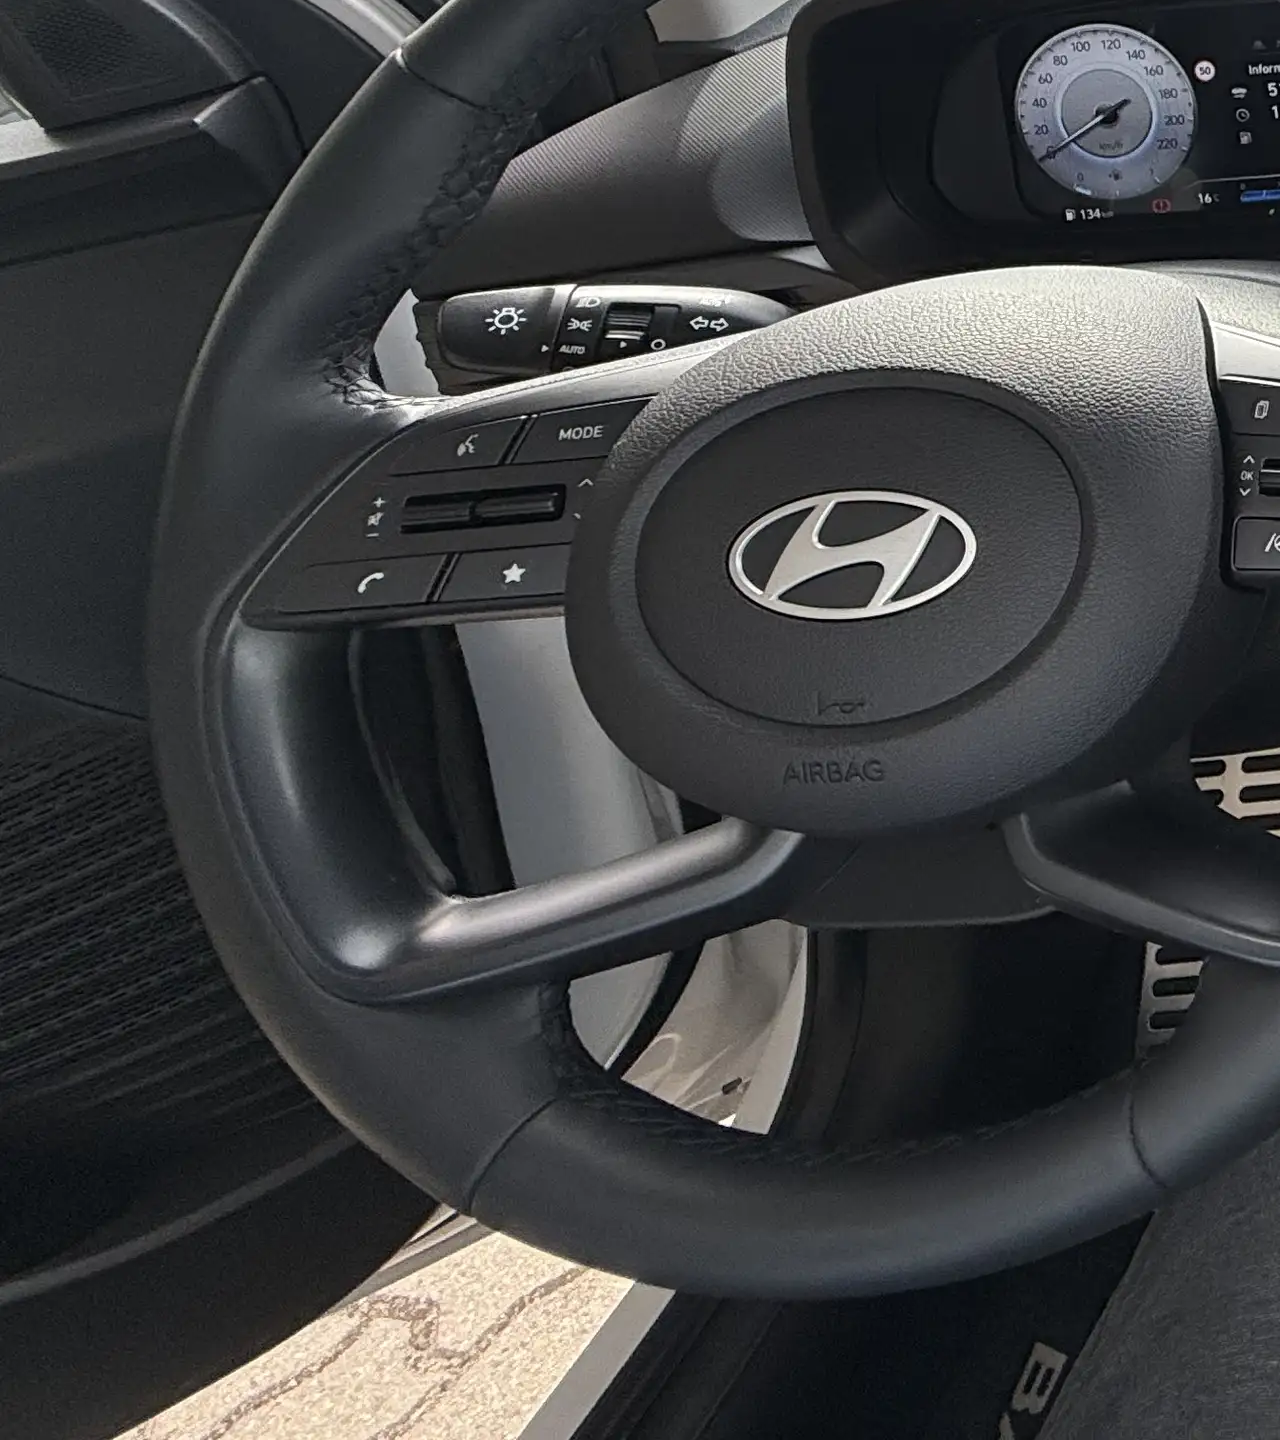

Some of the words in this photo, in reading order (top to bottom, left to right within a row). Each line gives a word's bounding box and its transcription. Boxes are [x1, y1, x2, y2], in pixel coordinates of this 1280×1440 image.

[1071, 41, 1091, 52] 100
[1101, 38, 1121, 50] 120
[1053, 55, 1068, 66] 80
[1126, 50, 1146, 61] 140
[1144, 65, 1164, 76] 160
[1200, 66, 1210, 74] 50
[1038, 74, 1053, 84] 60
[1159, 88, 1178, 99] 180
[1032, 98, 1047, 108] 40
[1164, 114, 1185, 126] 200
[1034, 124, 1048, 135] 20
[1157, 138, 1178, 150] 220
[1198, 193, 1212, 204] 16
[1080, 208, 1100, 220] 134
[559, 344, 586, 354] AUTO
[558, 424, 604, 442] MODE
[1240, 470, 1254, 481] OK
[782, 760, 886, 784] AIRBAG
